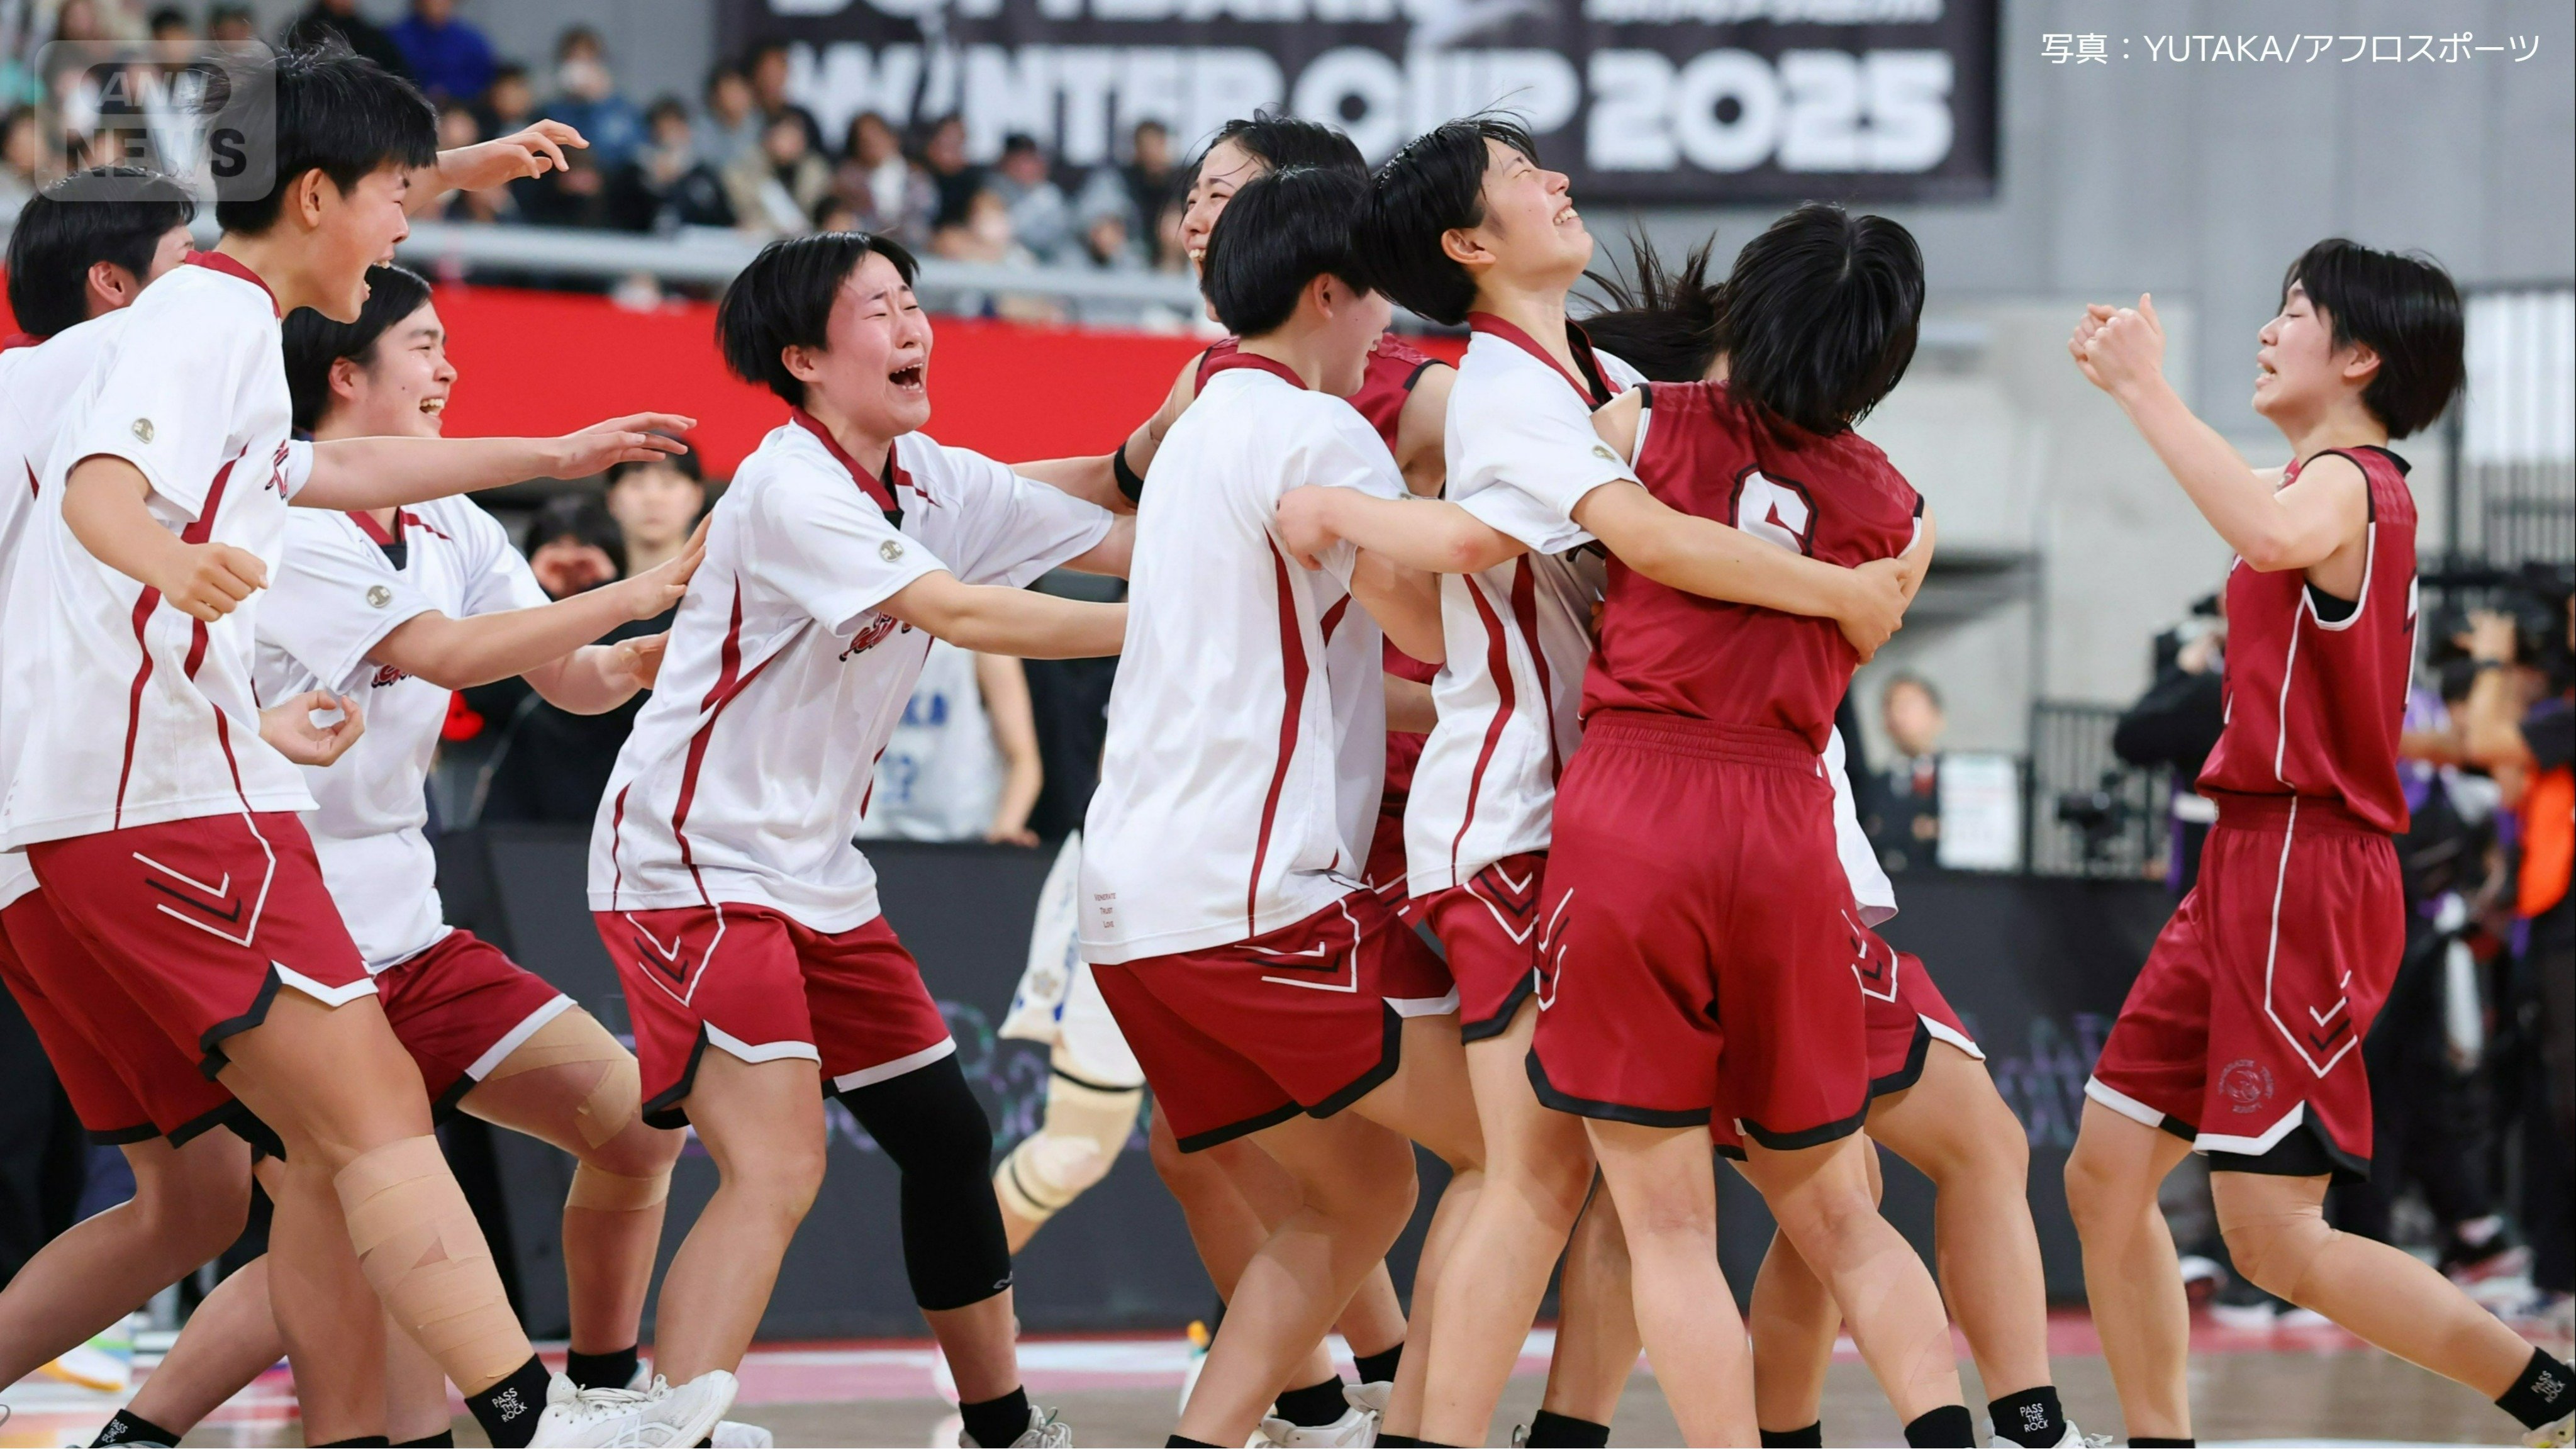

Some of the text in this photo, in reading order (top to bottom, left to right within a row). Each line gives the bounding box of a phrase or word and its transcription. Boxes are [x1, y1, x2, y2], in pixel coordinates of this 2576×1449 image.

[1588, 48, 1954, 173] 2025
[491, 1387, 518, 1408] PASS
[501, 1398, 518, 1413] THE
[501, 1402, 528, 1423] ROCK
[2019, 1403, 2044, 1416] PASS
[2026, 1413, 2044, 1423] THE
[2024, 1419, 2048, 1433] ROCK
